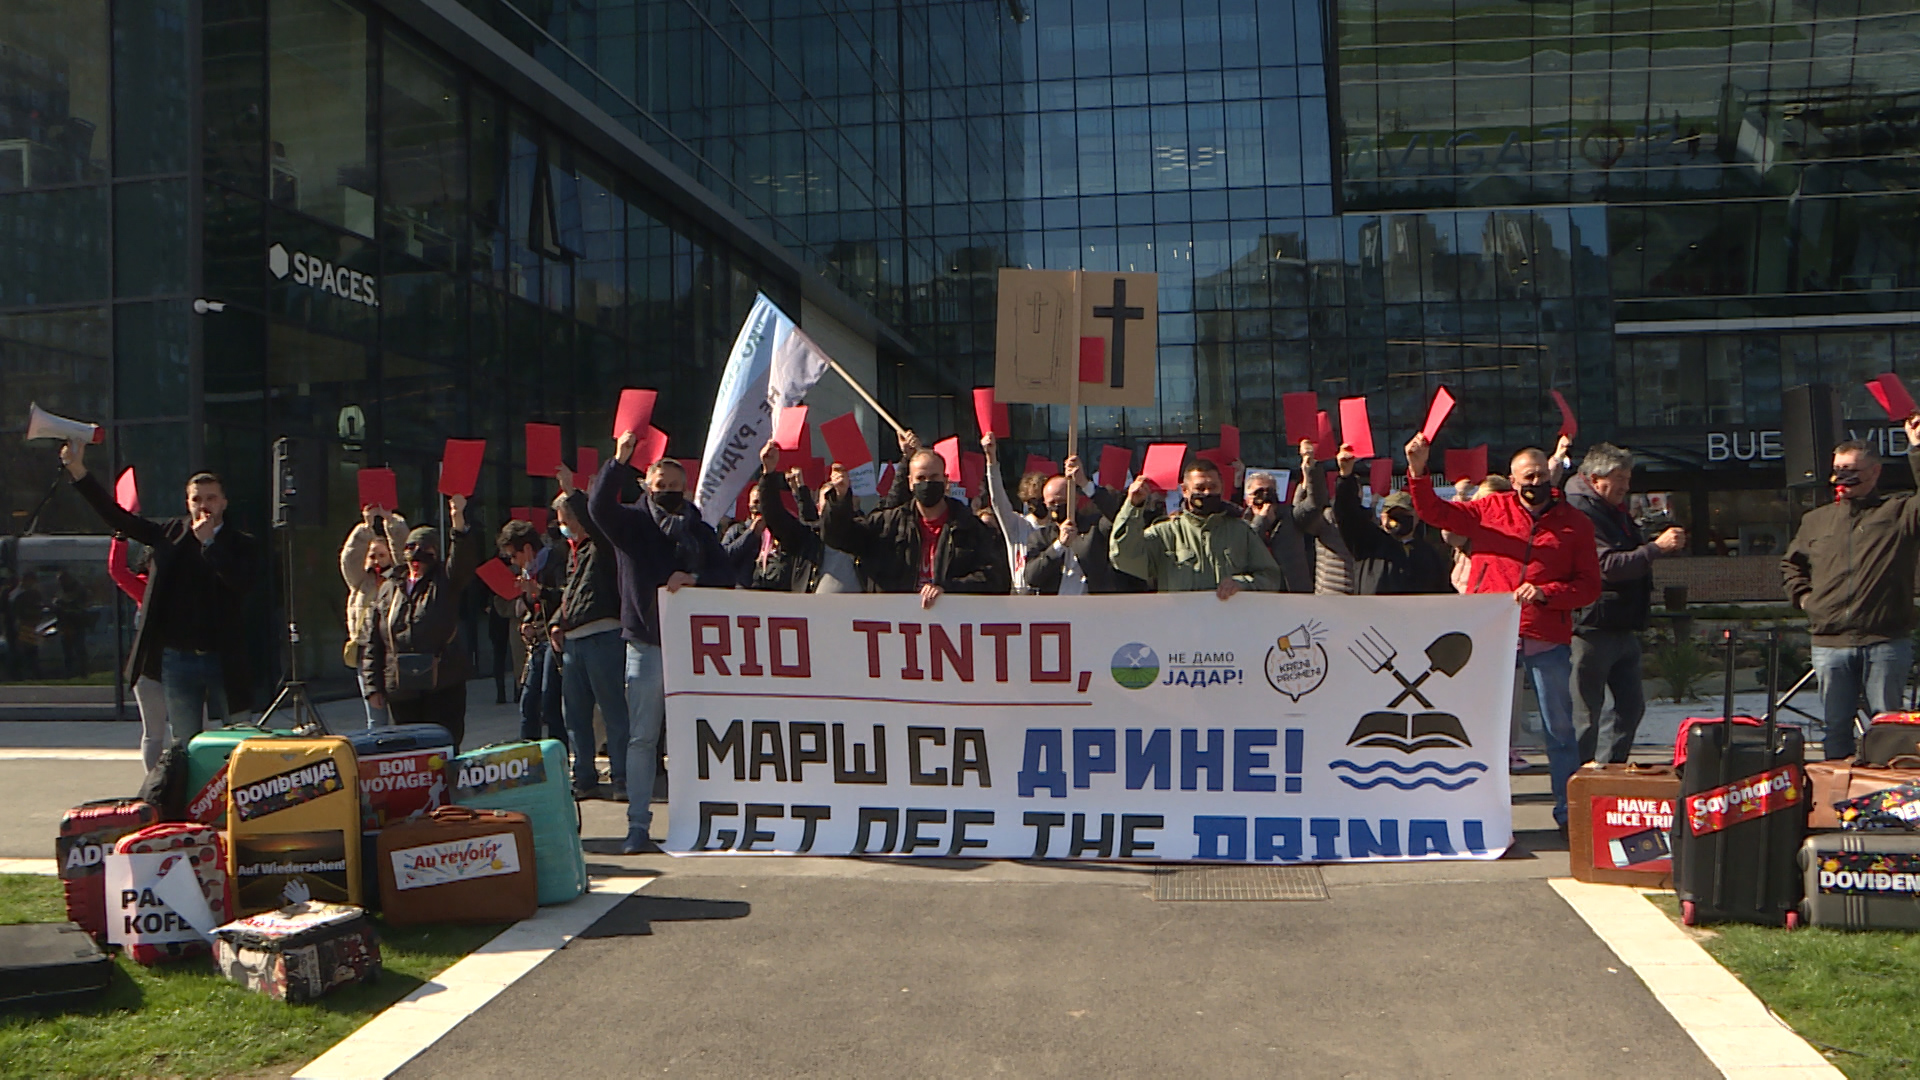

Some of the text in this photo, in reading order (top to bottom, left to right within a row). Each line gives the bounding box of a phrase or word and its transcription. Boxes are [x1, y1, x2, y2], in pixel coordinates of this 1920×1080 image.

[293, 251, 380, 307] SPACES.
[690, 615, 1093, 693] RIO TINTO,
[1168, 651, 1235, 666] НЕ ДАМО
[378, 759, 417, 776] BON
[696, 719, 1305, 798] МАРШ СА ДРИНЕ!
[235, 760, 337, 807] DOVIĐENJA!
[360, 771, 434, 793] VOYAGE!
[456, 757, 529, 790] ADDIO!
[1606, 811, 1642, 827] NICE
[1617, 798, 1671, 814] HAVE A
[691, 801, 832, 852] GET
[1022, 811, 1165, 859] THE
[237, 859, 346, 877] Auf Wiedersehen!
[414, 842, 498, 870] Au revoir!
